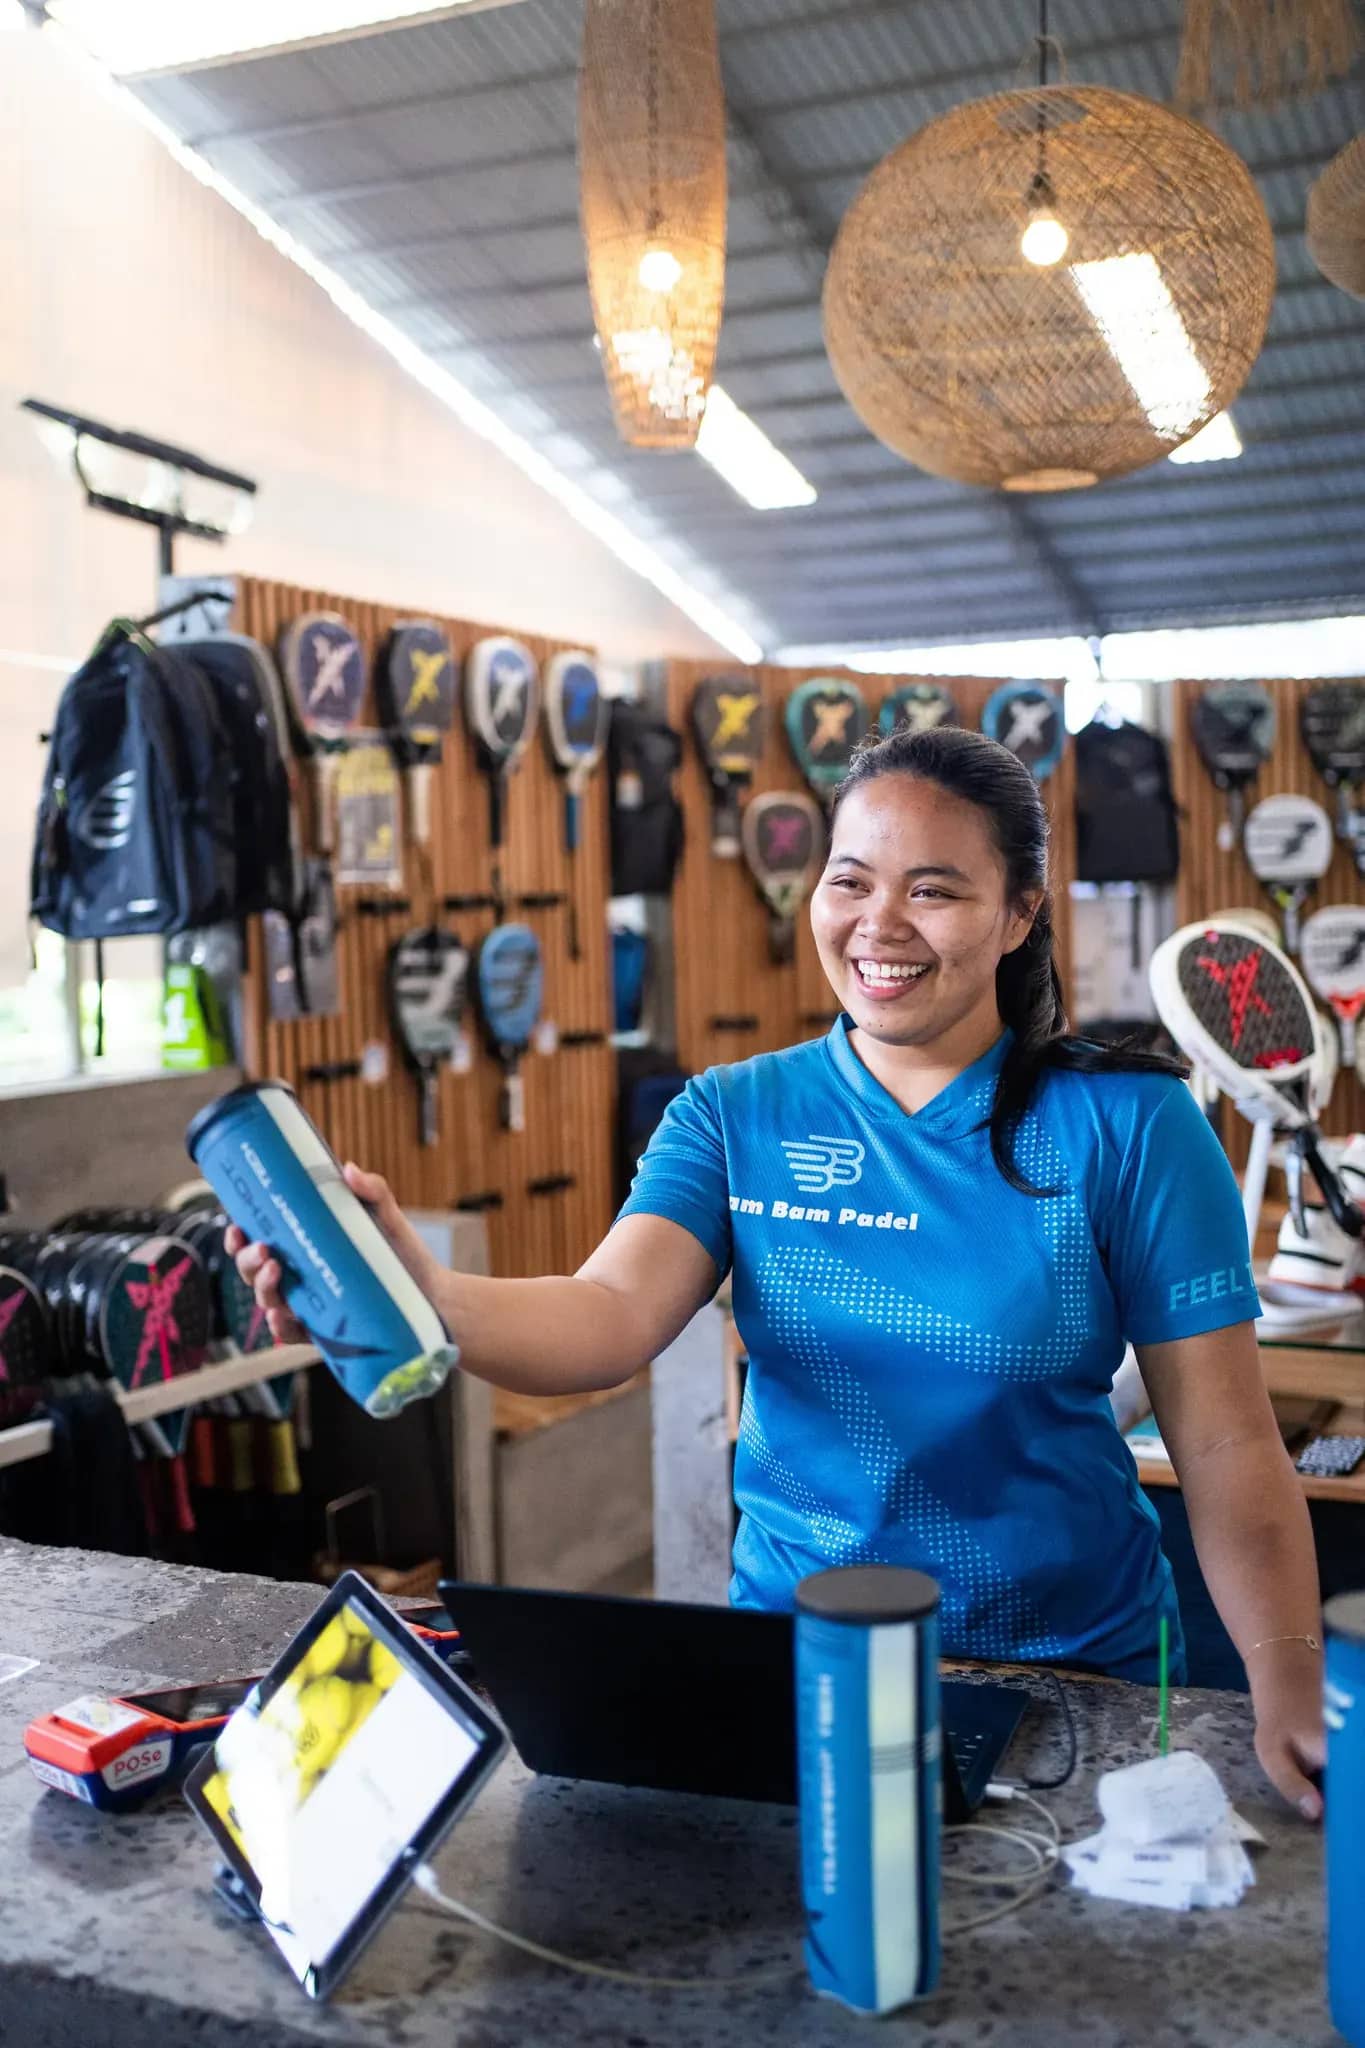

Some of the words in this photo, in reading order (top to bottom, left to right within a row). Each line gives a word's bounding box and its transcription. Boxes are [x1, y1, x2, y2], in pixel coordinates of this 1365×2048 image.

[729, 1196, 764, 1215] am
[771, 1200, 830, 1223] Bam
[838, 1208, 919, 1231] Padel
[1169, 1267, 1243, 1312] FEEL
[114, 1750, 161, 1777] POSe
